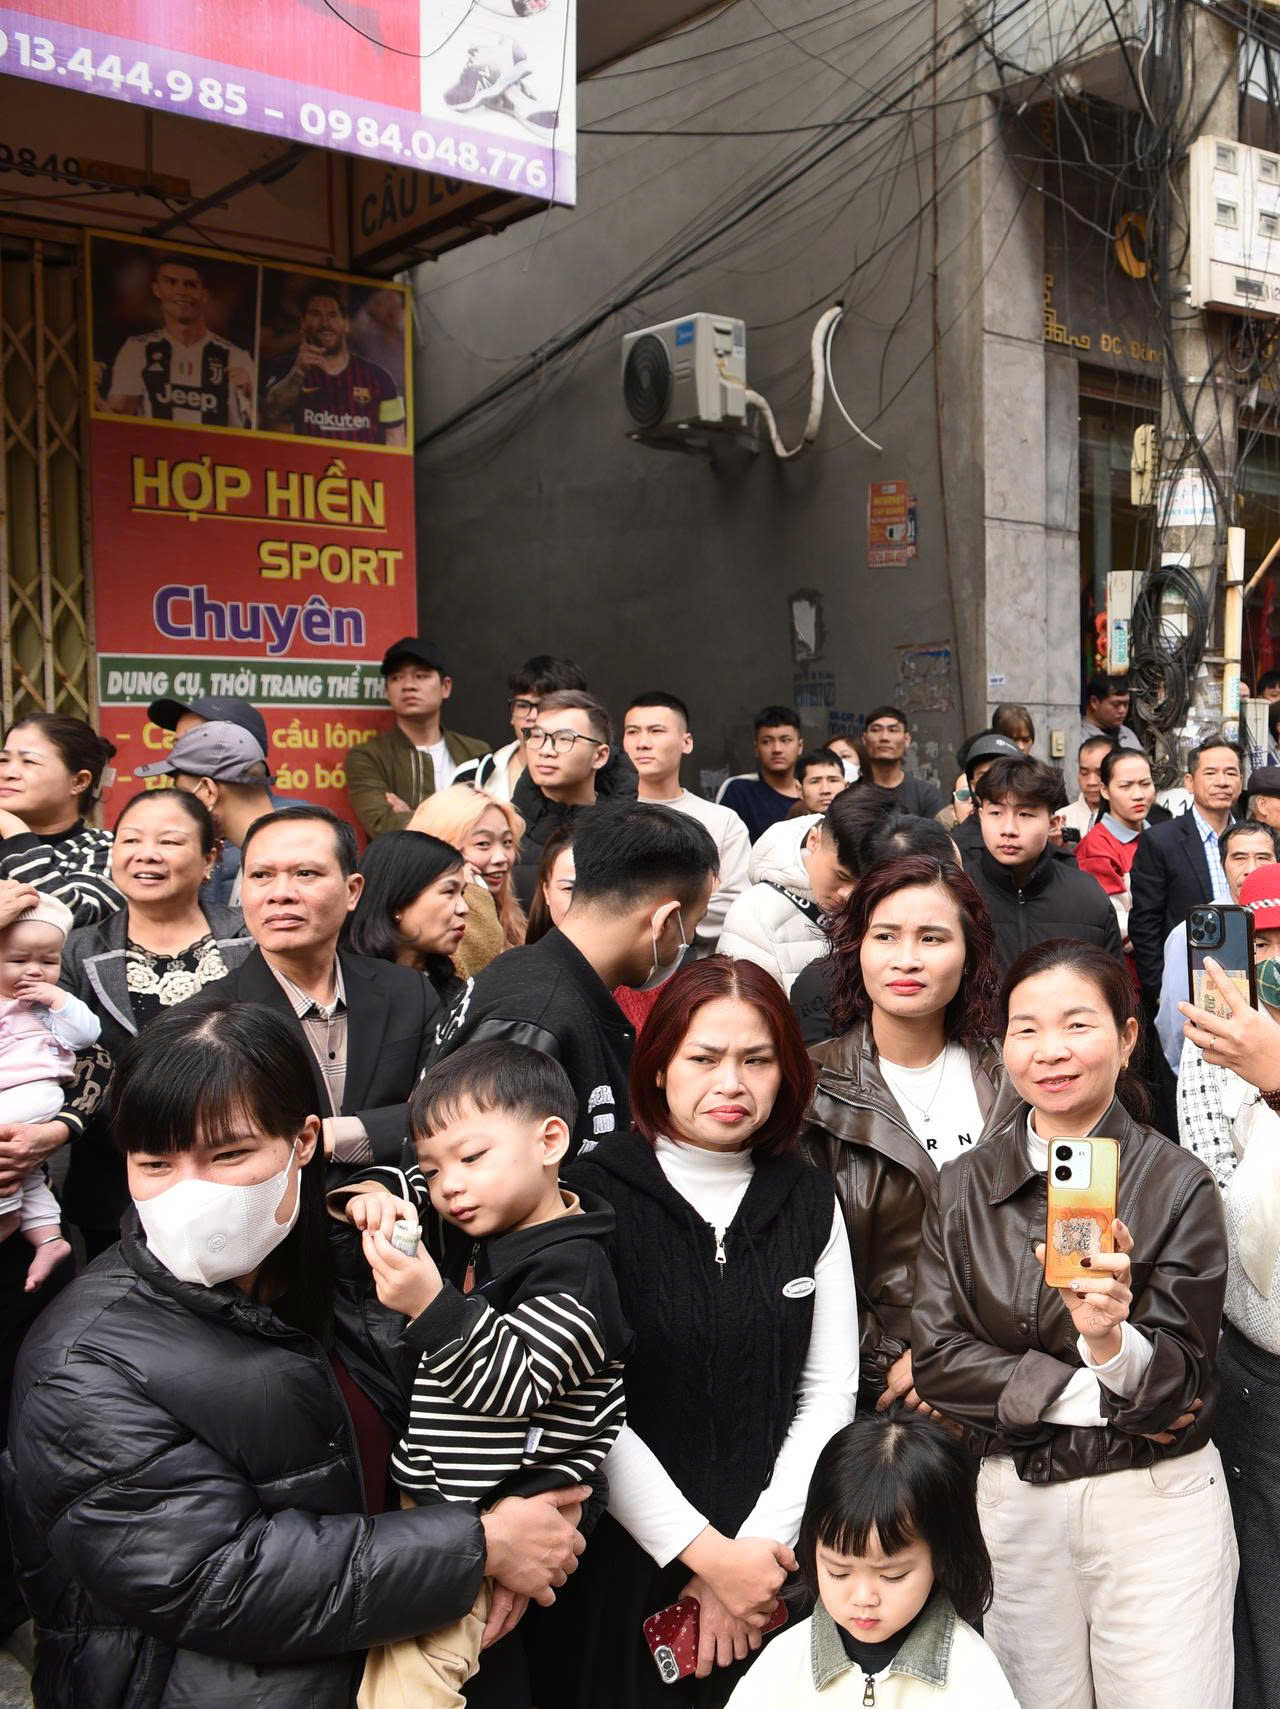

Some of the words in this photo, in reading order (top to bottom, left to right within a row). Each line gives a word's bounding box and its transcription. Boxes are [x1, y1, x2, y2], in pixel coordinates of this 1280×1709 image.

[299, 102, 549, 189] 0984.048.776
[156, 384, 217, 412] Jeep
[303, 408, 371, 429] Rakuten
[132, 456, 251, 522] HỢP
[265, 459, 386, 528] HIỀN
[258, 540, 403, 586] SPORT
[152, 584, 366, 656] Chuyên
[107, 671, 170, 702] DỤNG
[210, 667, 256, 697] THỜI
[260, 674, 322, 698] TRANG
[327, 664, 361, 698] THỂ
[363, 677, 388, 699] TH
[271, 718, 319, 749] cầu
[276, 763, 309, 790] áo
